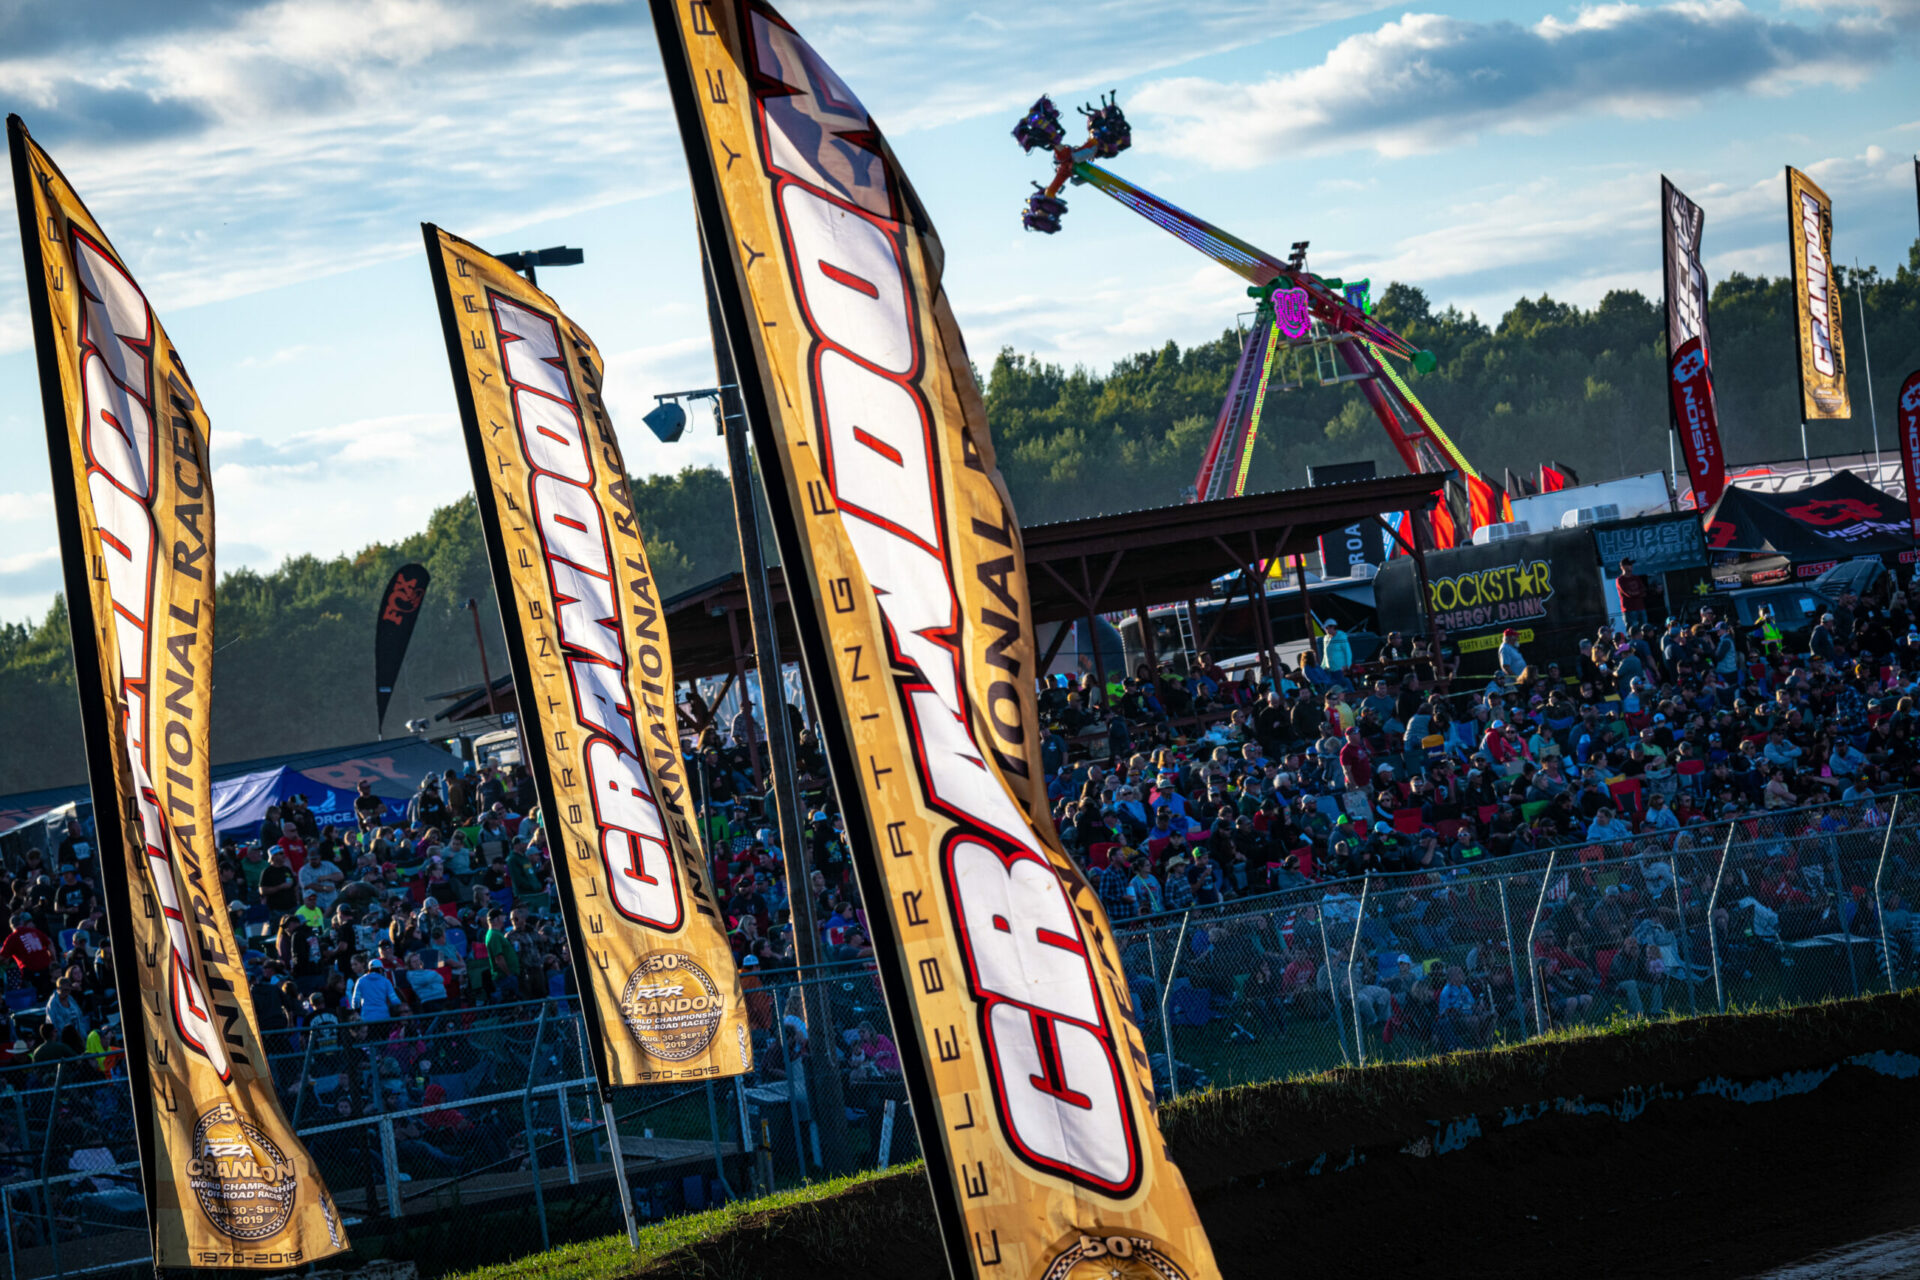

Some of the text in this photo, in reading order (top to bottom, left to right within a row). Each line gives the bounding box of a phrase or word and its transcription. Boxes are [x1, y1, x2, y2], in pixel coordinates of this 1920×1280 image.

[38, 174, 67, 337] YEAR
[1800, 189, 1835, 378] CRANDON
[1827, 268, 1844, 374] INTERNATION
[1683, 385, 1709, 475] VISION
[164, 336, 208, 582] RACEWA
[1908, 416, 1920, 503] ISION
[490, 419, 534, 569] FIFTY
[1344, 523, 1365, 565] ROA
[1600, 520, 1698, 554] HYPER
[1814, 519, 1911, 539] VISION
[383, 573, 420, 626] FOX
[484, 285, 684, 934] CRANDON
[736, 0, 1143, 1199] CRANDON
[1499, 597, 1544, 621] DRINK
[569, 325, 716, 918] INTERNATIONAL RACEWAY
[690, 0, 1002, 1267] CELEBRATING FIY YEA
[67, 219, 233, 1086] CDON
[528, 600, 610, 970] CELEBRATING
[163, 599, 250, 1066] INTERNATIONAL
[648, 953, 689, 970] 50TH
[621, 994, 724, 1016] CRANDON
[636, 985, 685, 1000] RZR
[654, 1010, 723, 1024] CHAMPIONSHIP
[680, 1019, 711, 1028] RACES
[665, 1041, 687, 1049] 2019
[638, 1065, 720, 1081] 1970-2019
[191, 1181, 297, 1194] WORLD CHAMPIONSHIP
[257, 1190, 284, 1201] RACES
[232, 1206, 247, 1215] 30
[236, 1215, 263, 1225] 2019
[197, 1250, 304, 1264] 1970-2019
[1079, 1234, 1152, 1258] 50TH
